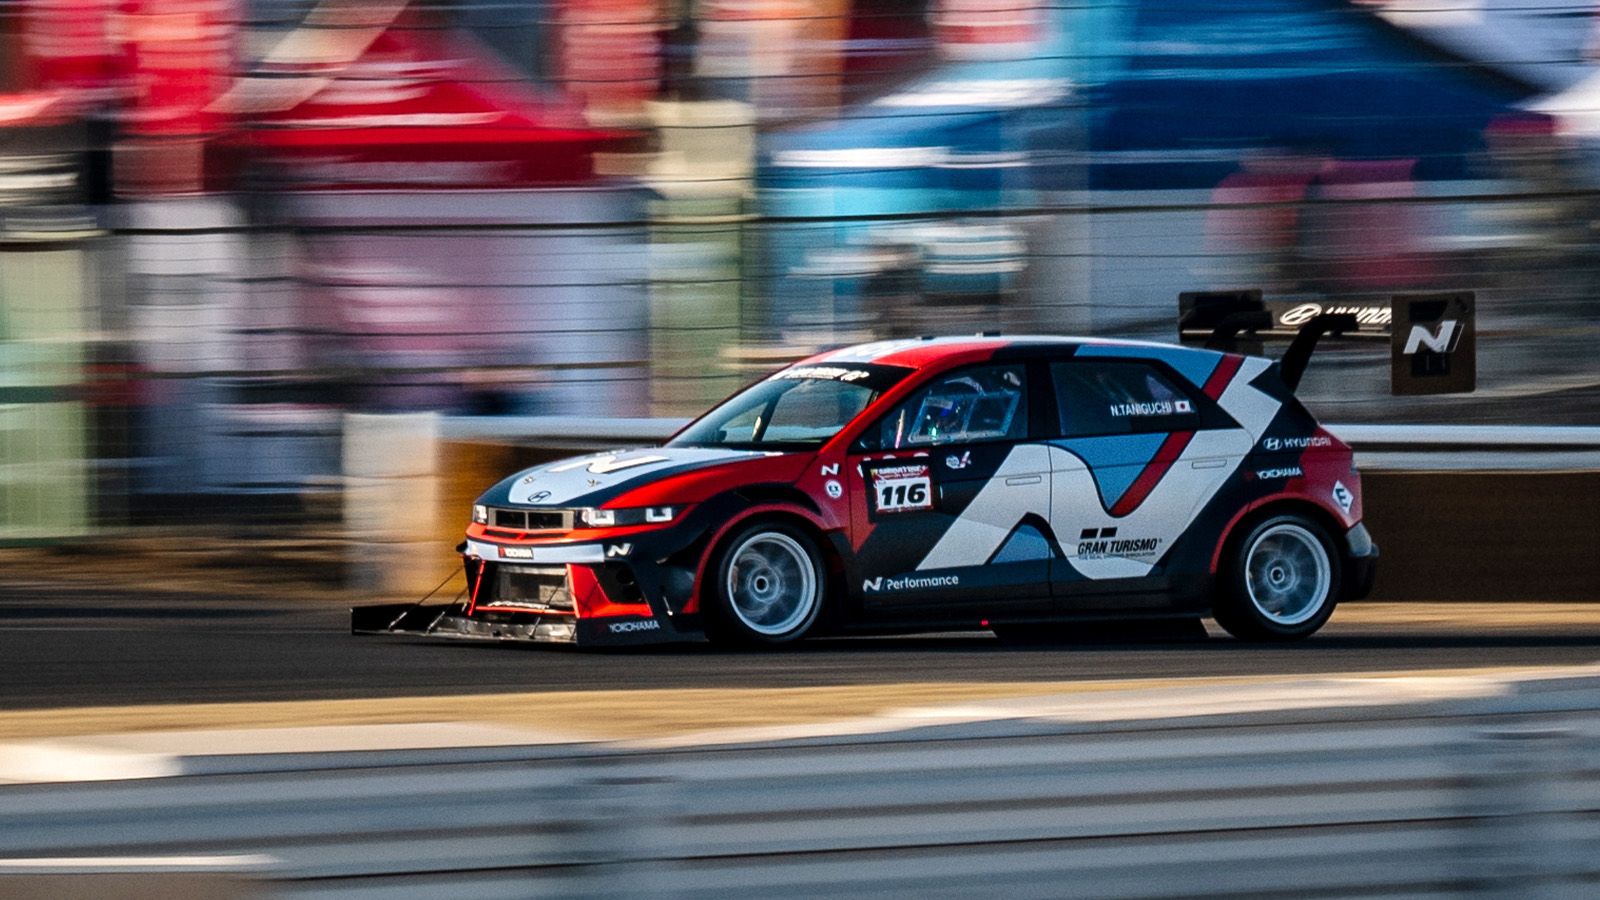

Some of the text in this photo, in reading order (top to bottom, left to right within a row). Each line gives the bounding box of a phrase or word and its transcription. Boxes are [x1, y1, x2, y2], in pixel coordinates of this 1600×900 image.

[1403, 320, 1458, 354] N
[1110, 401, 1172, 417] N.TANIGUCHI
[1284, 437, 1332, 448] HYUNDAI
[821, 463, 839, 476] N
[1256, 466, 1303, 480] YOKOHAMA
[881, 483, 927, 506] 116
[607, 543, 632, 557] N
[1077, 541, 1109, 555] GRAN
[887, 575, 959, 590] Performance
[608, 619, 660, 633] YOKOHAMA
